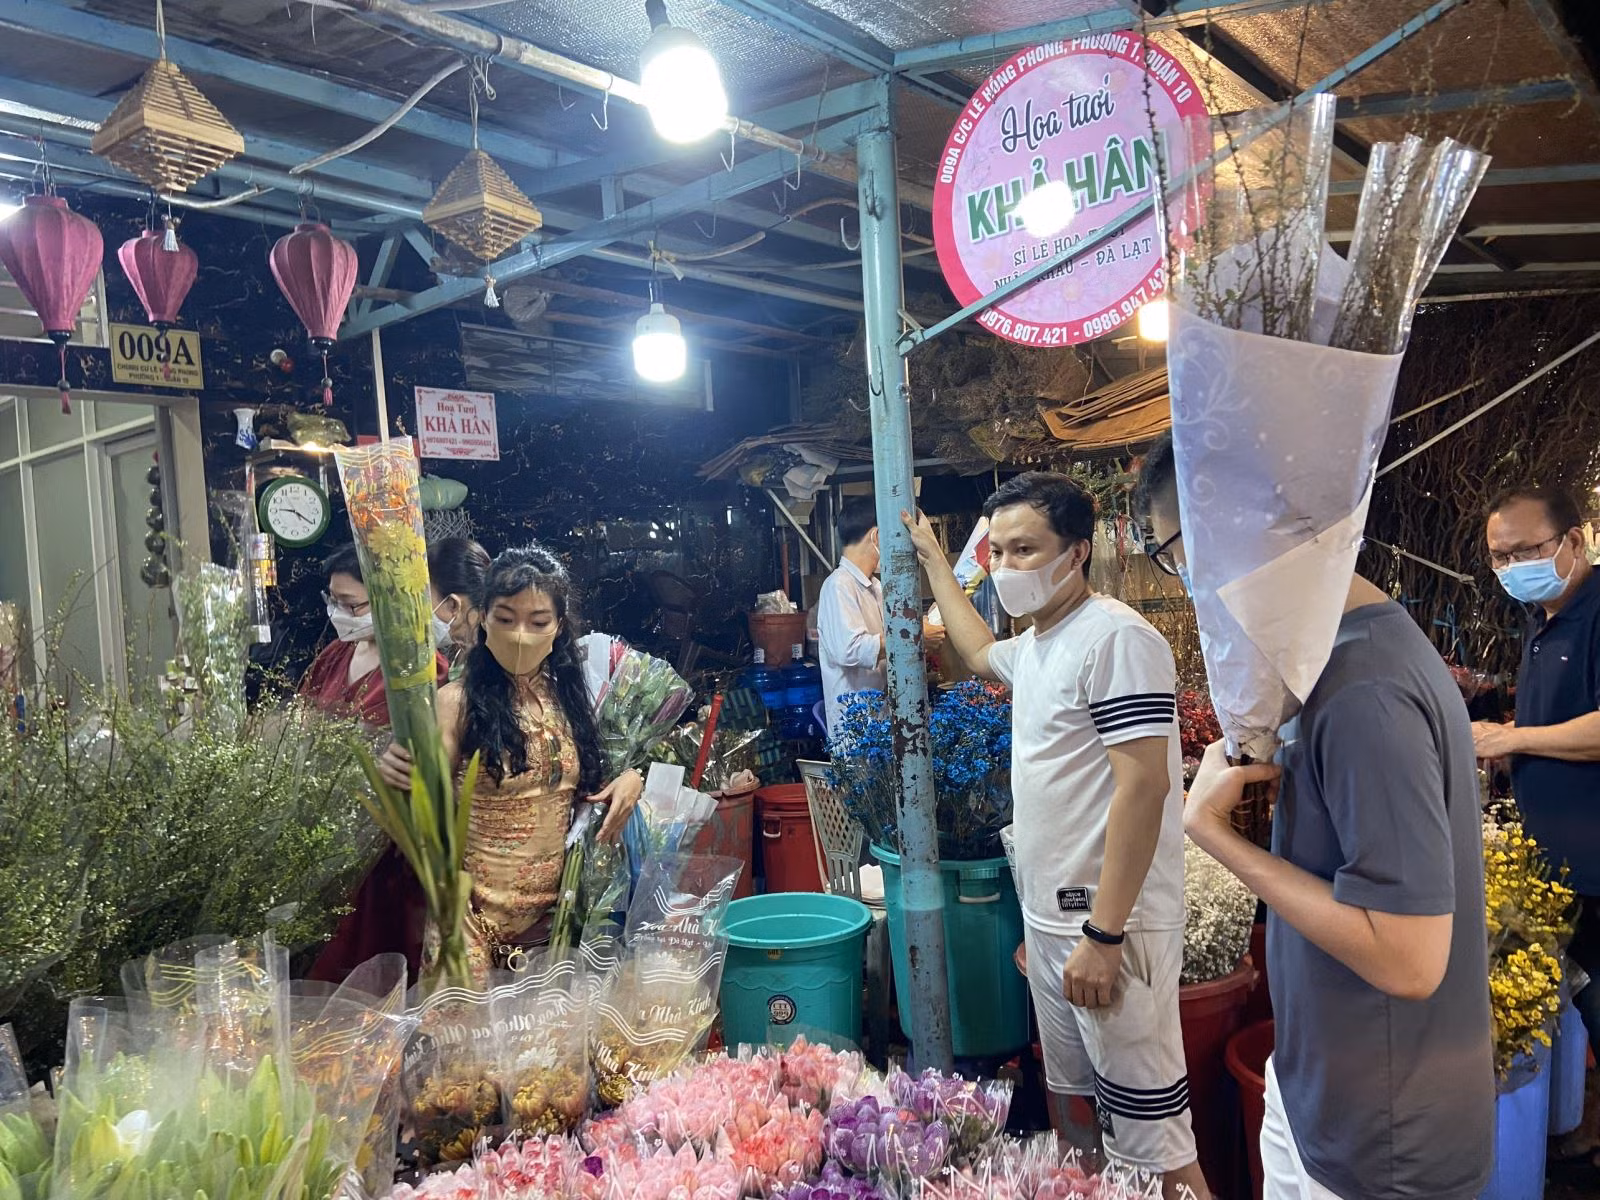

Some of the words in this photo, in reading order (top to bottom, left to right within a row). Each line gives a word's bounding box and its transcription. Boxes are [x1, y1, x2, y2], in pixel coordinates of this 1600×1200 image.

[940, 147, 961, 184] 009A
[953, 118, 973, 145] C/C
[1173, 80, 1193, 104] 10
[1001, 98, 1062, 154] Hoa
[1061, 74, 1115, 126] tươi
[1096, 245, 1117, 266] ĐÀ
[1121, 237, 1152, 260] LẠT
[1083, 267, 1167, 338] 0986.947.42
[118, 330, 195, 367] 009A
[424, 412, 457, 433] KHẢ
[461, 414, 491, 435] HÂN
